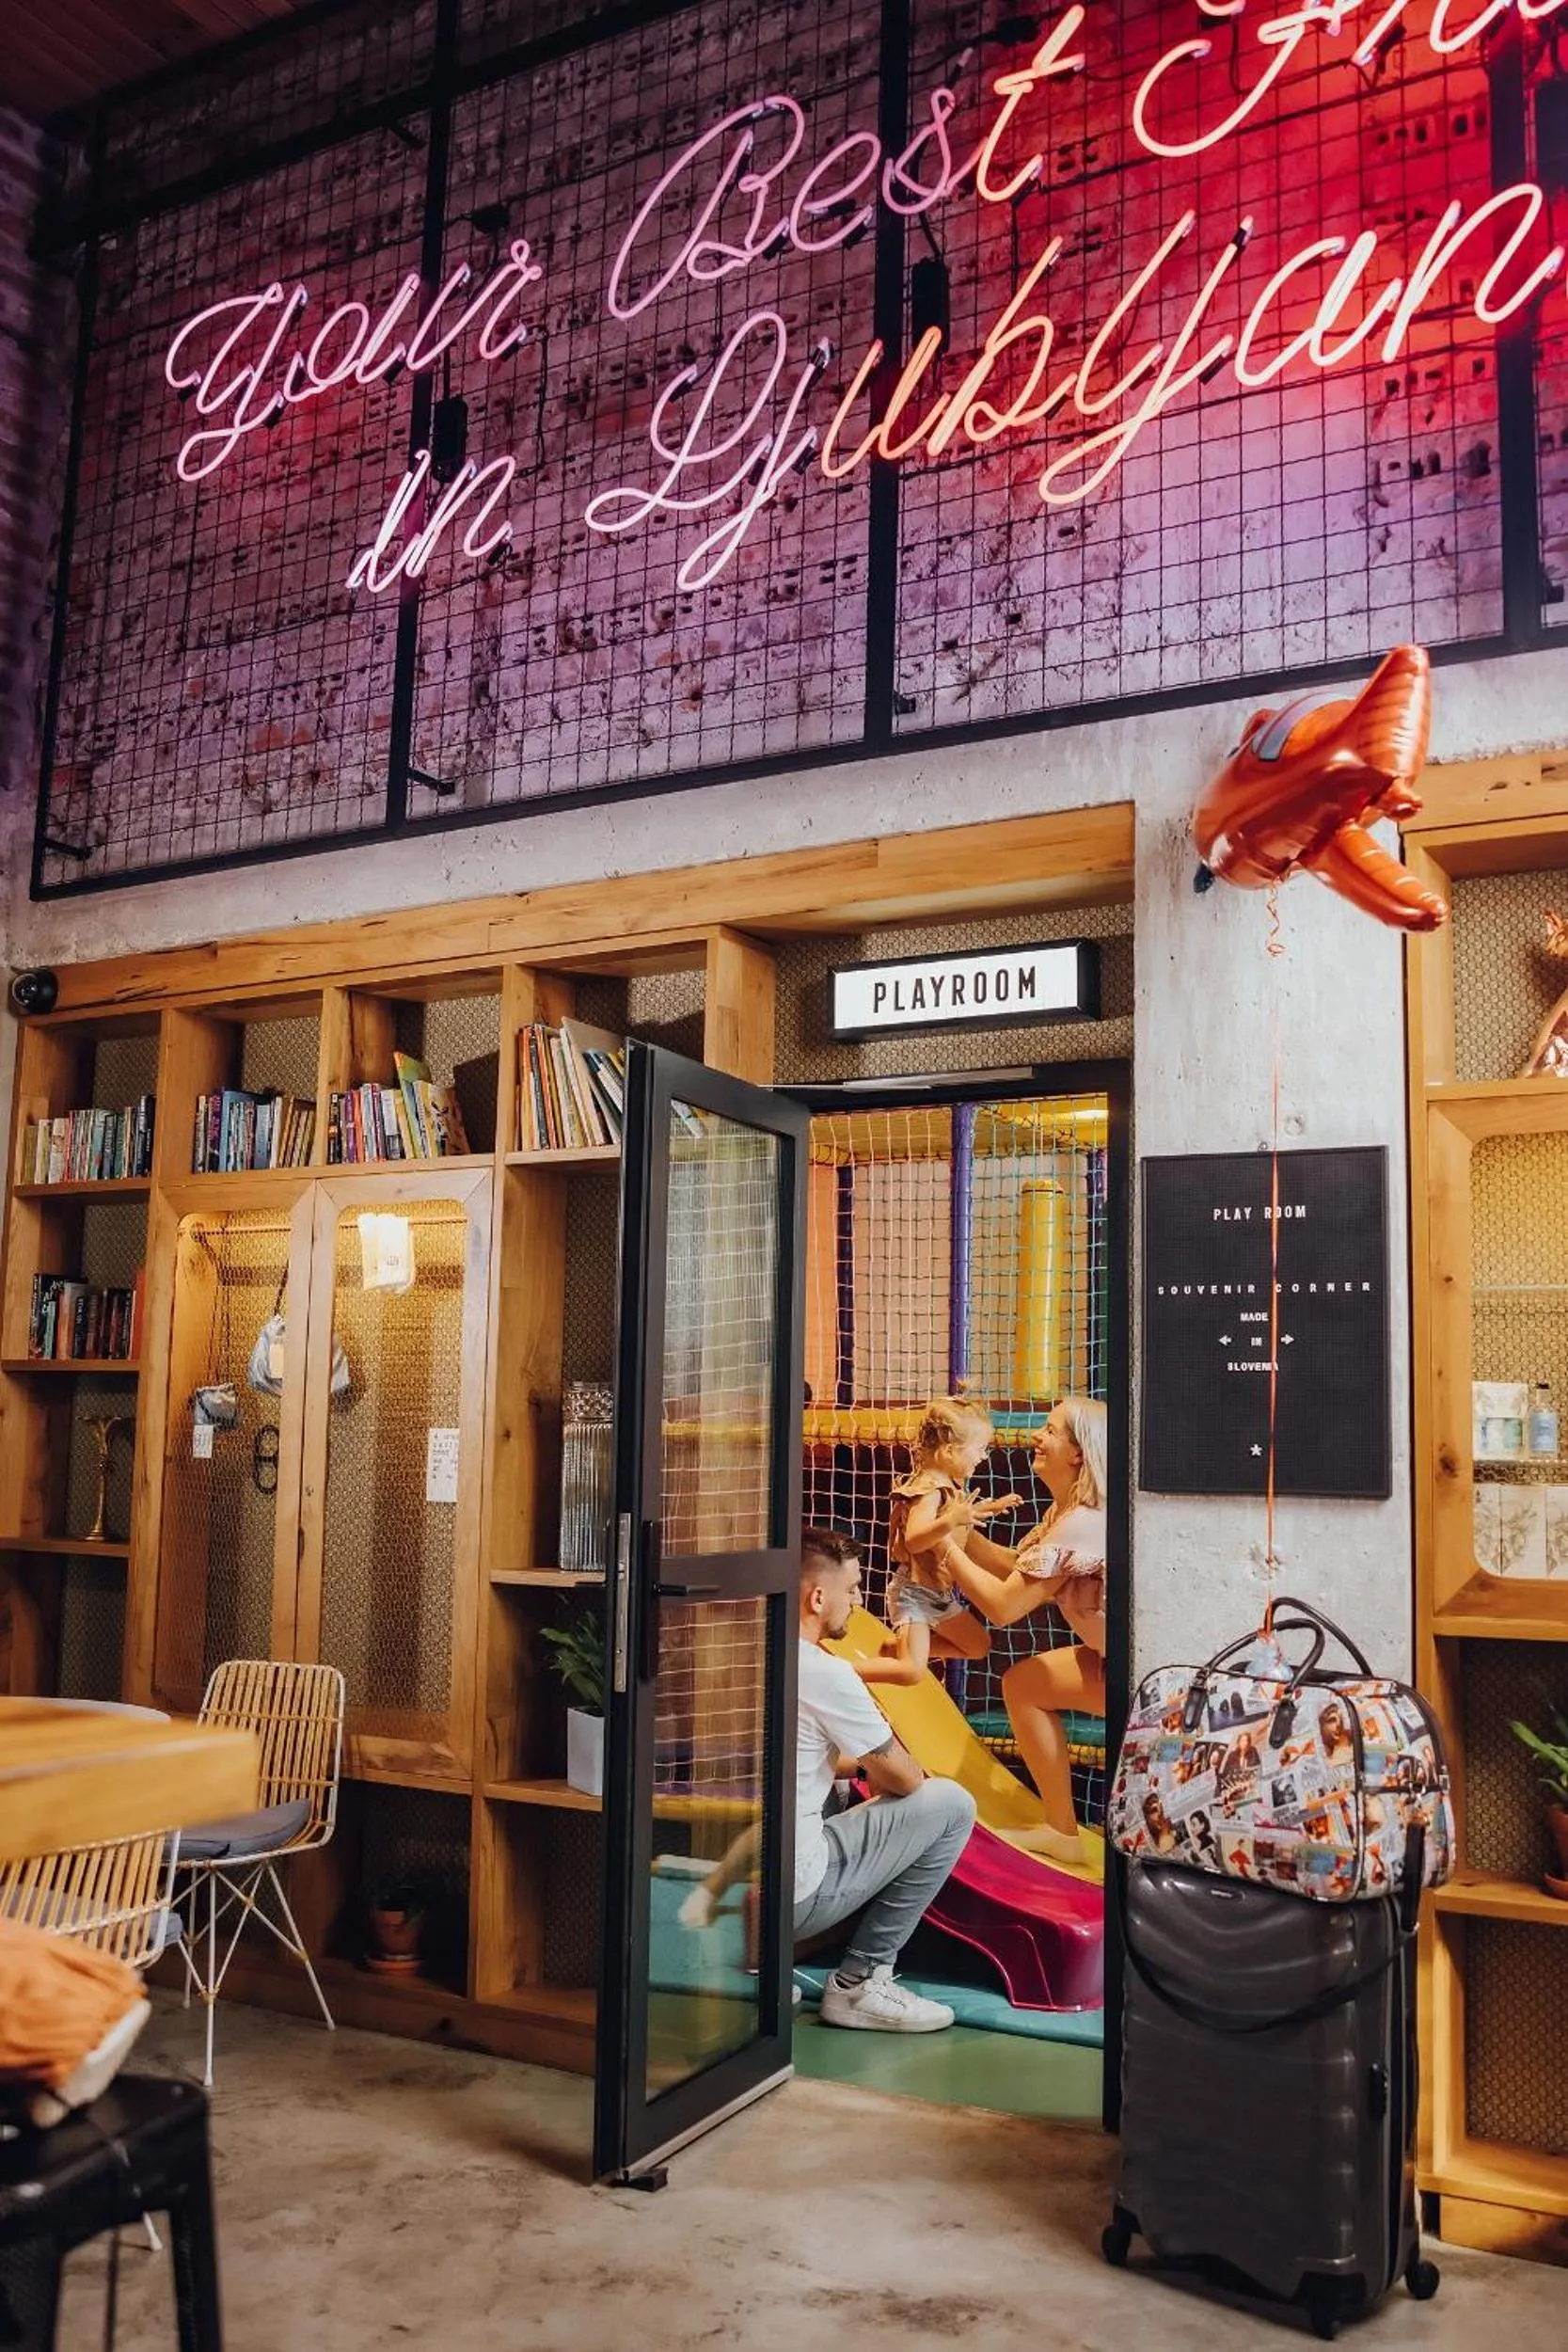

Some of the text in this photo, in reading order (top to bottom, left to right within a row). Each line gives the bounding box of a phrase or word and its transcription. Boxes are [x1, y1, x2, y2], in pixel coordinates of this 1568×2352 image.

[608, 5, 1085, 319] Best
[584, 183, 1568, 591] Ljubljan
[873, 965, 1037, 1013] PLAYROOM
[1212, 1205, 1307, 1221] PLAY ROOM
[1158, 1281, 1370, 1295] SOUVENIR CORNER
[1240, 1311, 1270, 1322] MADE
[1250, 1337, 1263, 1346] IN
